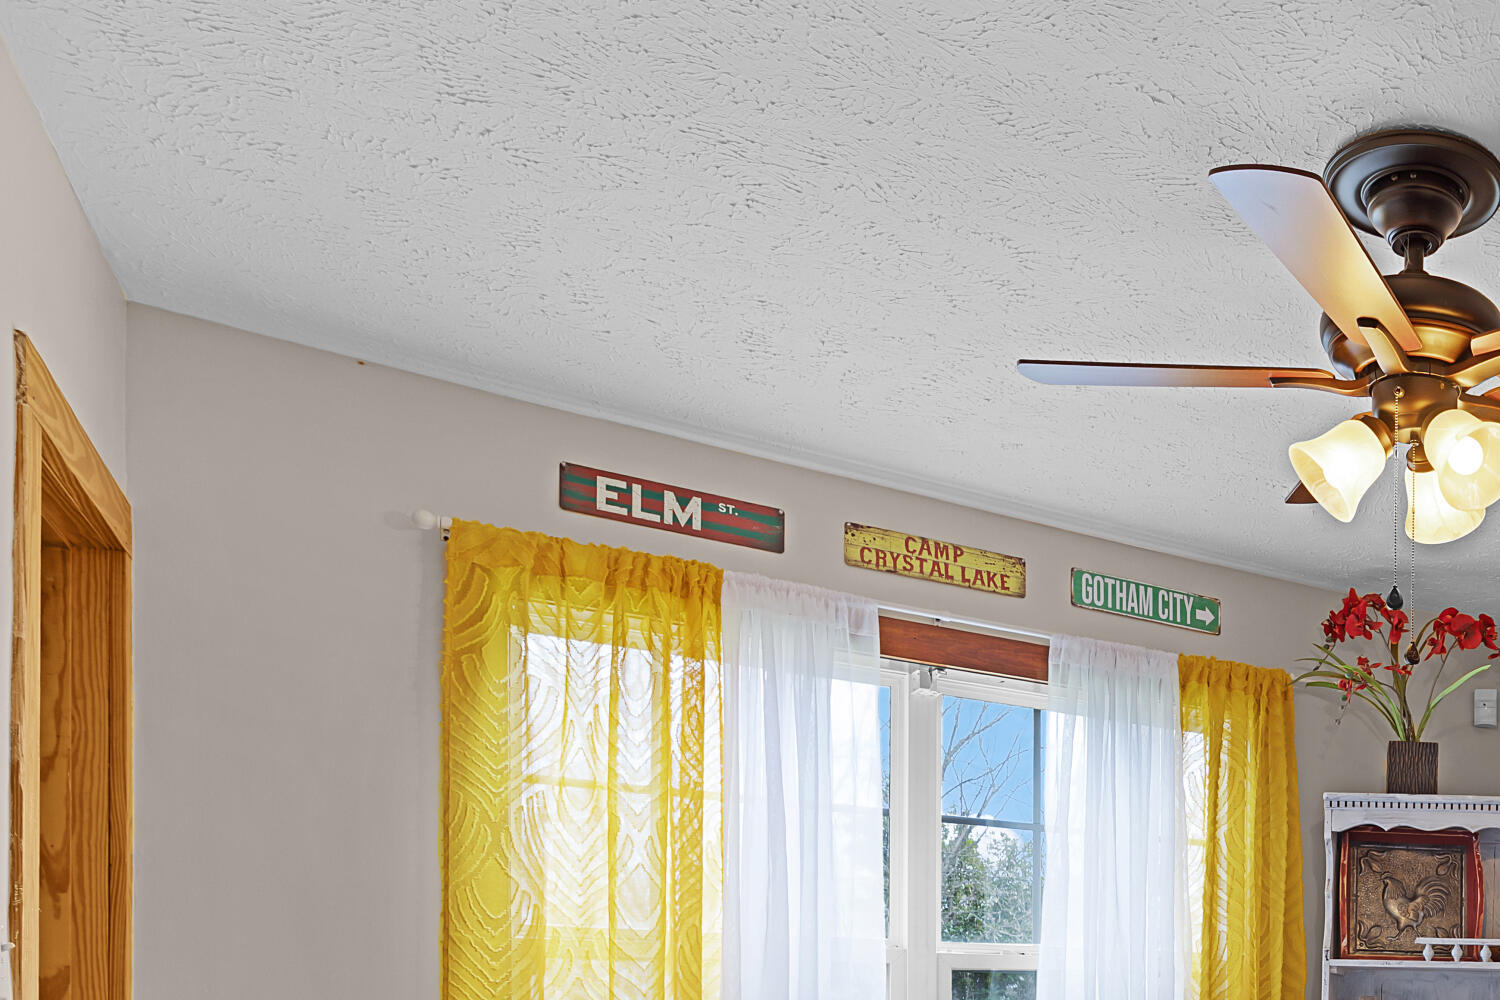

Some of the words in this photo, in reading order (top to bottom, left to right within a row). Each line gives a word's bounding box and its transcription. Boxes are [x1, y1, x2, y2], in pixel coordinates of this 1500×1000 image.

[596, 475, 702, 531] ELM
[718, 502, 739, 516] ST.
[859, 546, 954, 581] CRYSTAL
[961, 566, 1011, 591] LAKE
[904, 536, 965, 563] CAMP
[1081, 573, 1153, 617] GOTHAM
[1158, 589, 1194, 624] CITY
